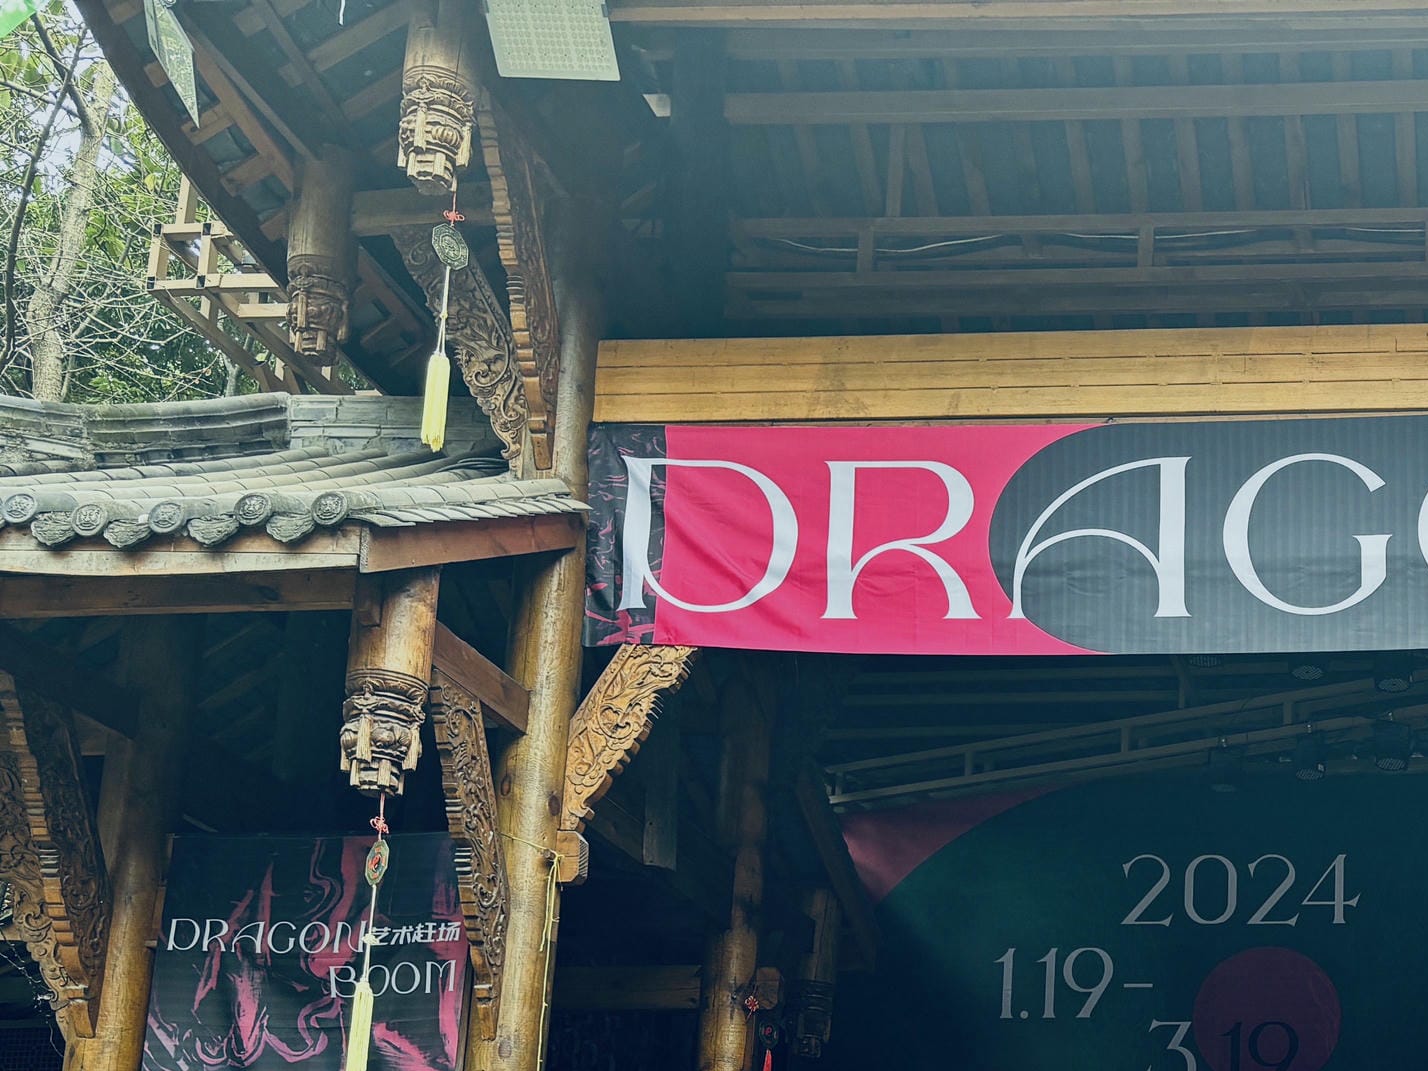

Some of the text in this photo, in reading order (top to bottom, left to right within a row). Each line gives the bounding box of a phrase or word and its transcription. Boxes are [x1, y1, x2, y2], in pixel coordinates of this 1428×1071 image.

[1121, 854, 1361, 926] 2024
[167, 918, 461, 954] DRAGON 艺术赶场
[329, 959, 456, 999] BOOM
